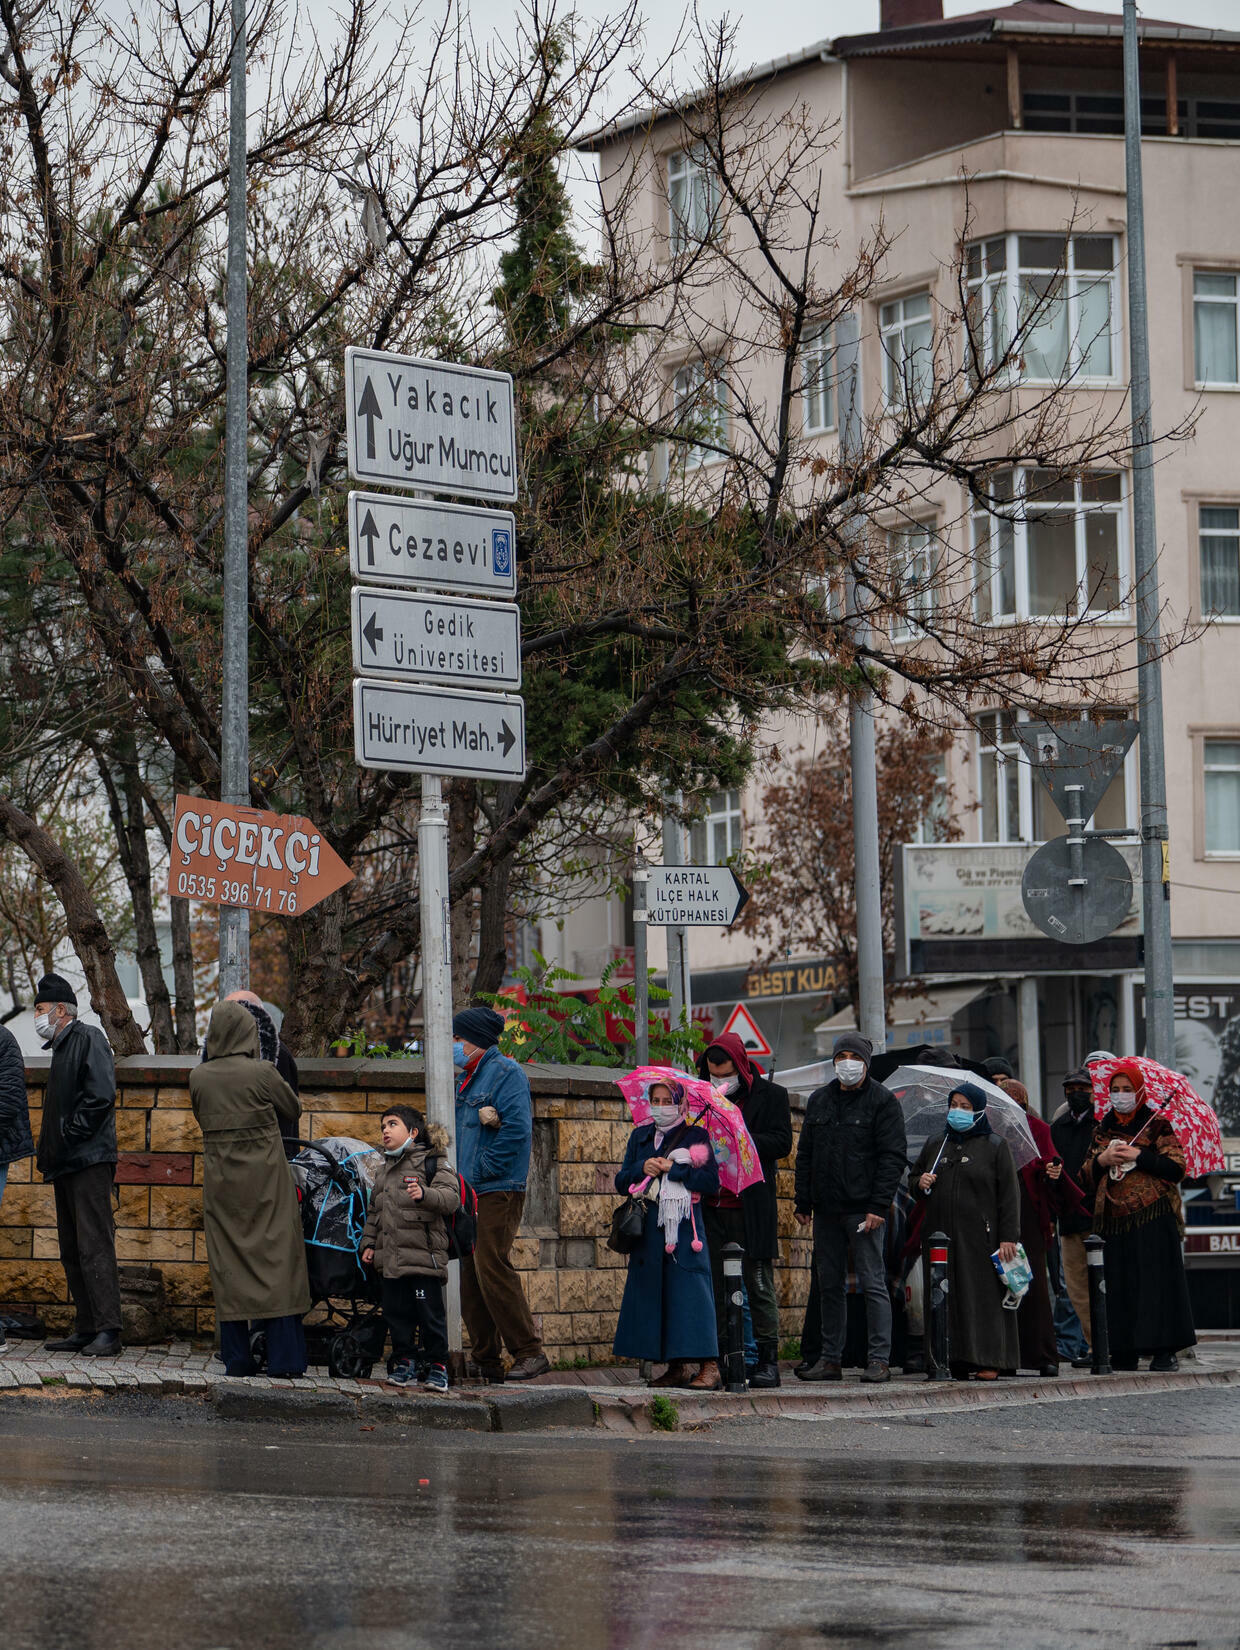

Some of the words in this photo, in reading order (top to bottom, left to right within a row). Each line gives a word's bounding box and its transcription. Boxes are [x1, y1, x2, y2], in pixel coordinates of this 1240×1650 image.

[386, 372, 498, 424] Yakacık
[388, 427, 435, 472] Uğur
[438, 436, 512, 477] Mumcu
[388, 523, 488, 568] Cezaevi
[424, 610, 474, 638] Gedik
[393, 633, 505, 674] Üniversitesi
[368, 712, 446, 754] Hürriyet
[452, 721, 494, 752] Mah.
[177, 872, 216, 899] 0535
[220, 880, 249, 904] 396
[255, 886, 272, 908] 71
[278, 890, 297, 912] 76
[656, 887, 683, 904] İLÇE
[688, 889, 720, 901] HALK
[665, 872, 710, 884] KARTAL
[648, 907, 729, 922] KÜTÜPHANESİ
